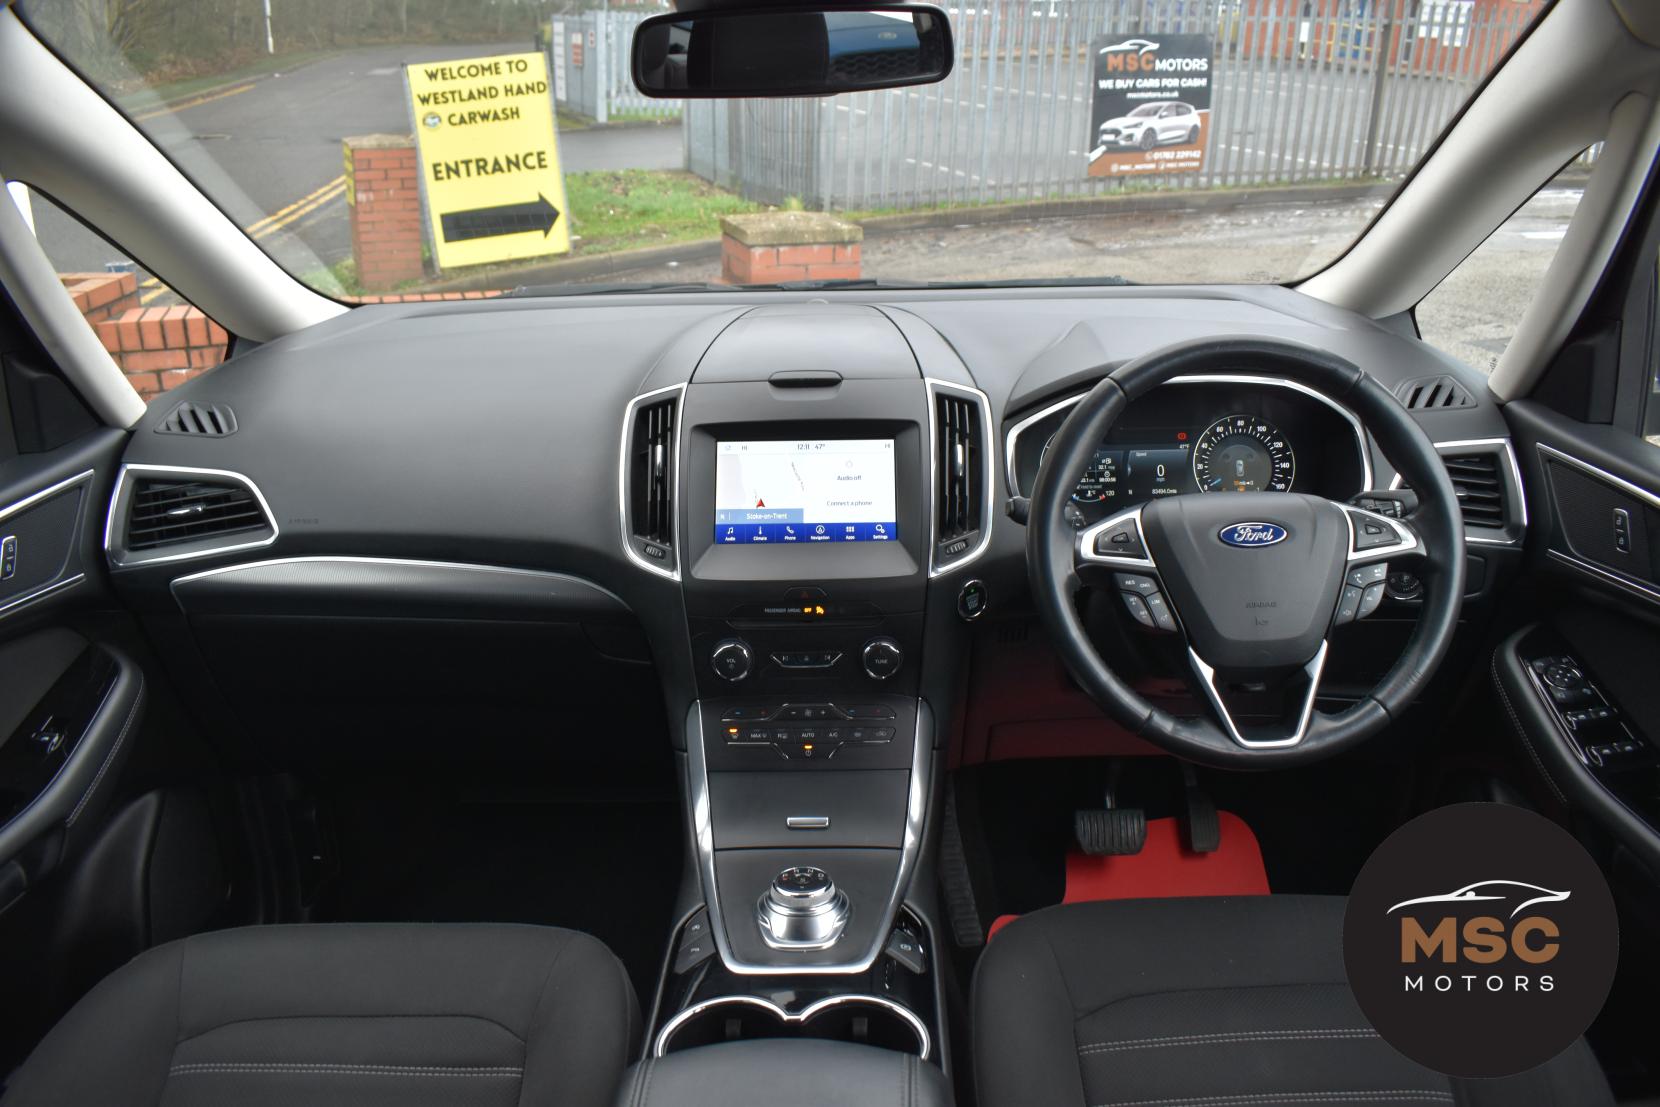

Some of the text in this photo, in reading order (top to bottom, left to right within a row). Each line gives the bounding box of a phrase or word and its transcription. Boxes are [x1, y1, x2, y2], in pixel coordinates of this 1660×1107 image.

[425, 59, 528, 82] WELCOME TO
[1107, 53, 1208, 72] MSC MOTORS
[1098, 80, 1115, 89] WE
[1115, 79, 1135, 89] BUY
[1136, 78, 1161, 88] CARS
[1162, 78, 1180, 88] FOR
[417, 81, 547, 106] WESTLAND HAND
[447, 107, 520, 127] CARWASH
[432, 151, 548, 181] ENTRANCE
[1157, 464, 1165, 477] 0
[746, 512, 788, 520] Stoke-on-Trent
[1234, 524, 1274, 542] Ford
